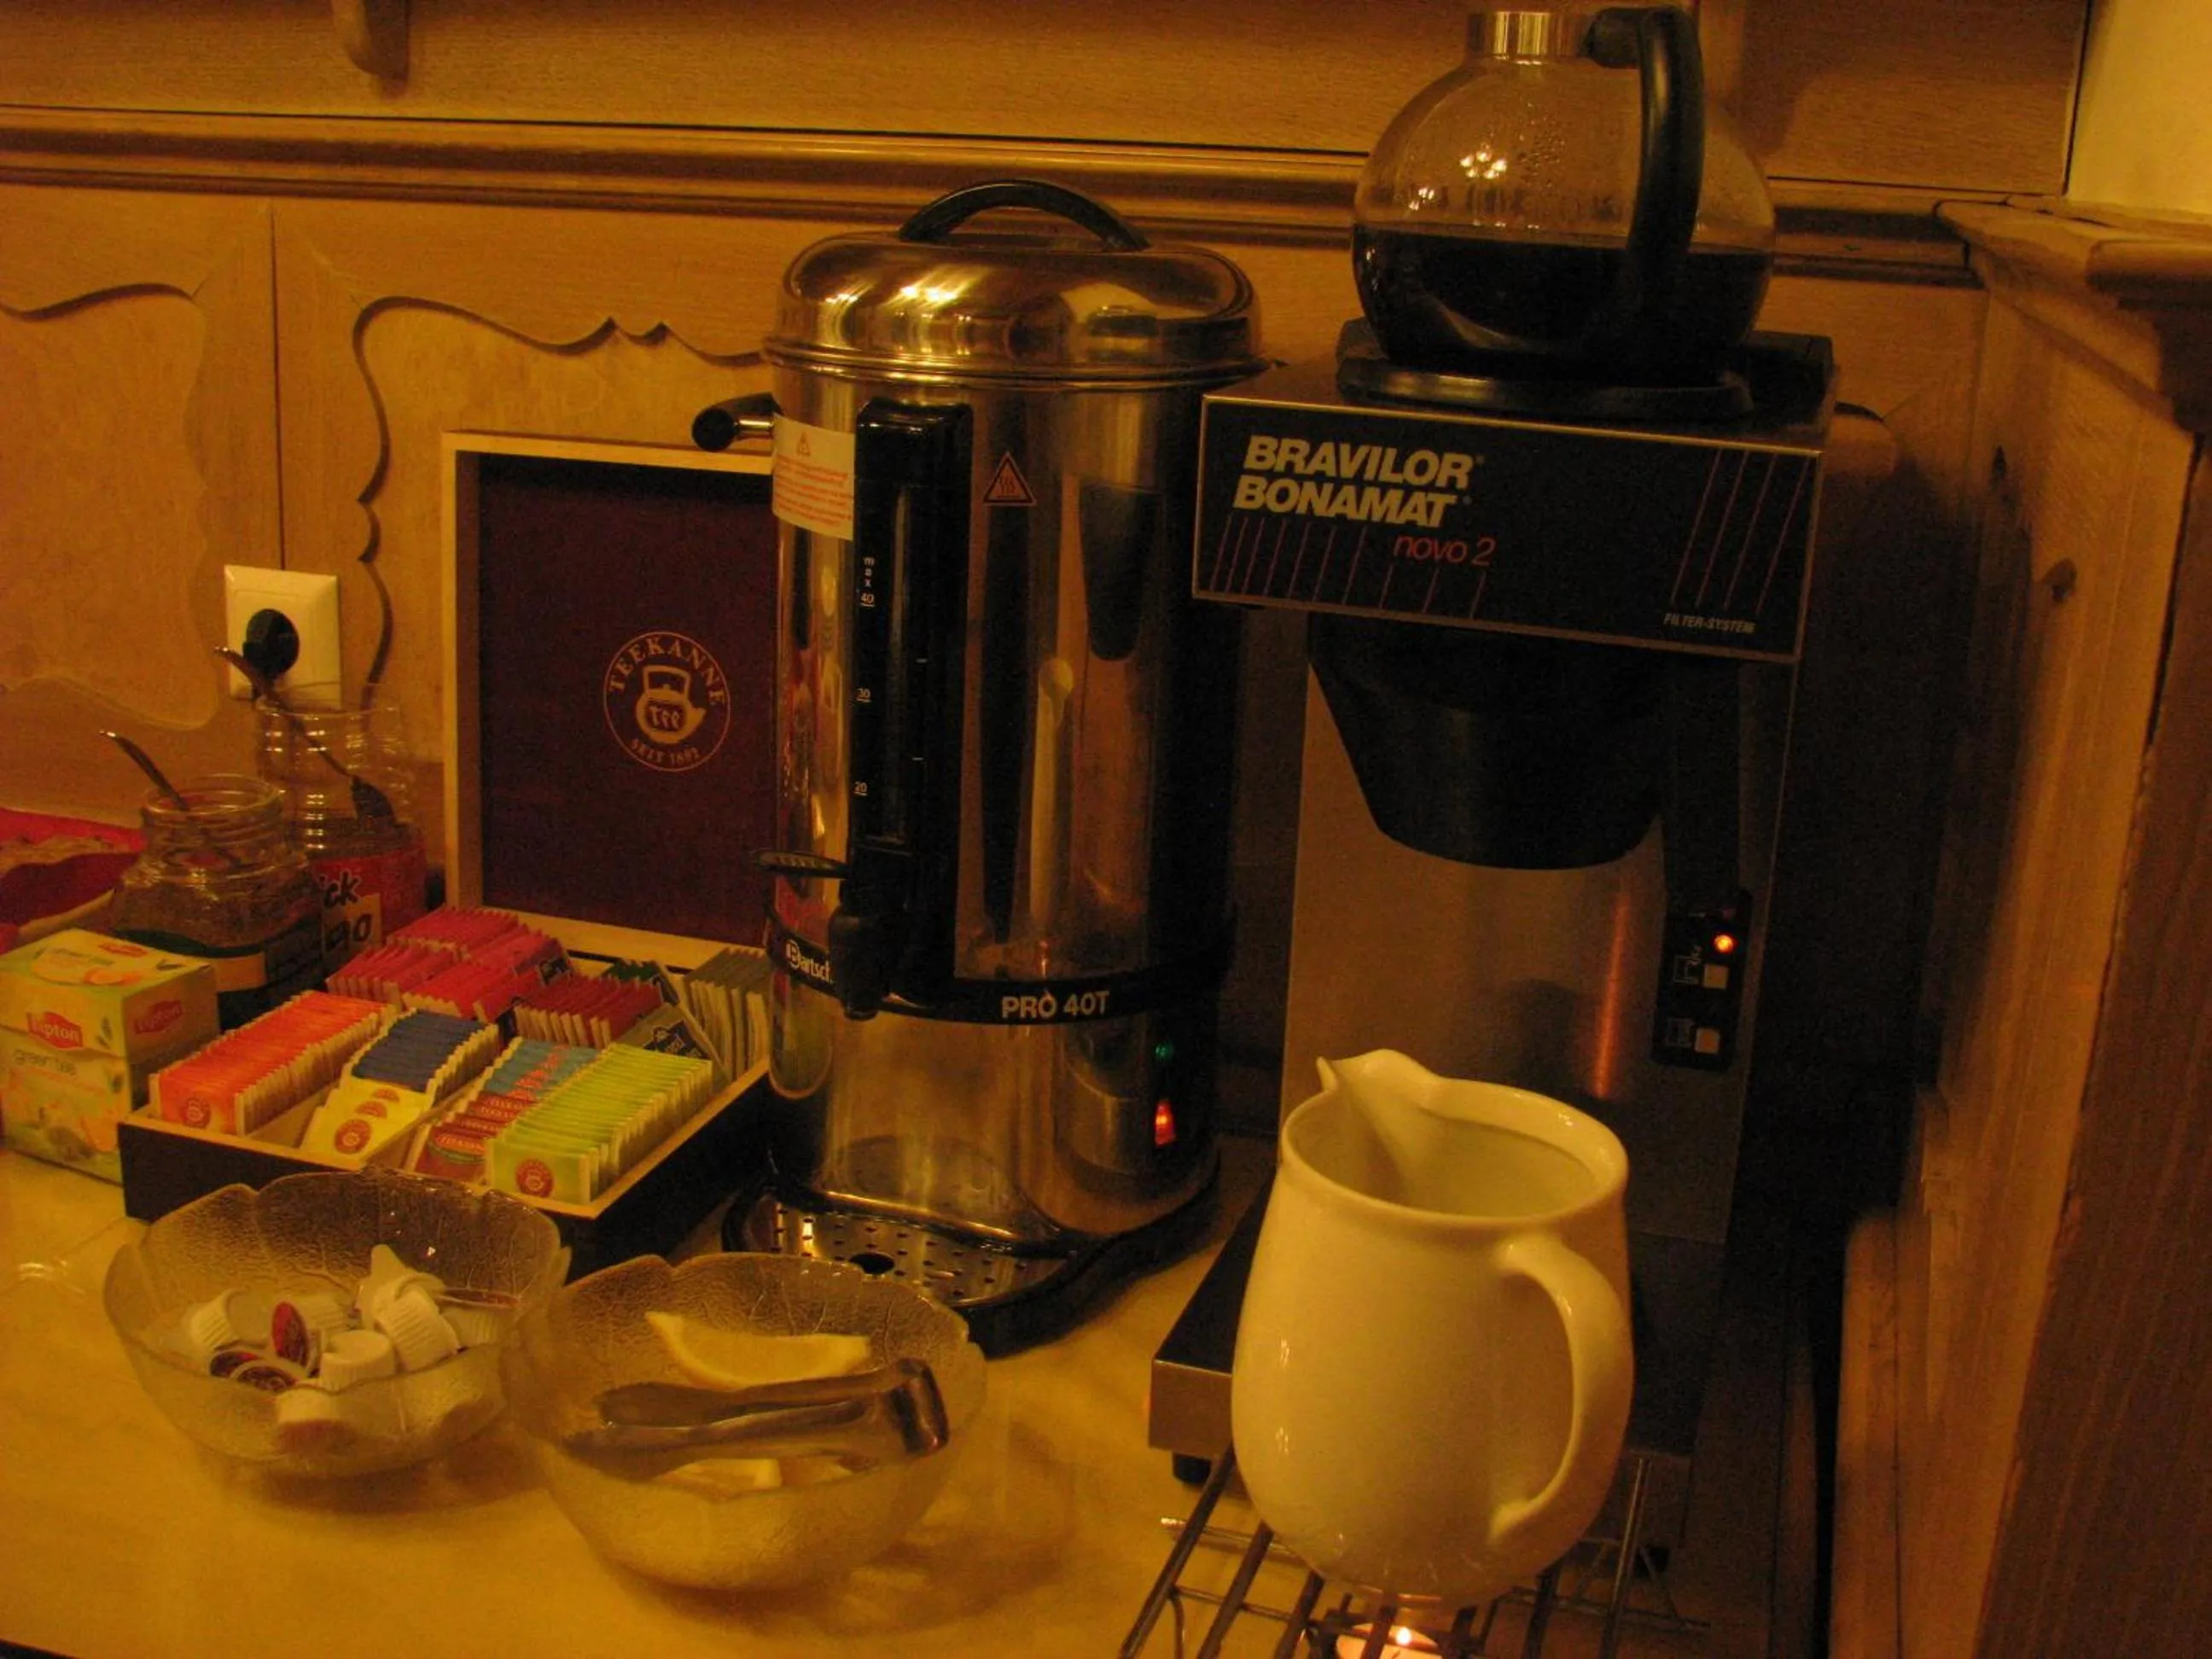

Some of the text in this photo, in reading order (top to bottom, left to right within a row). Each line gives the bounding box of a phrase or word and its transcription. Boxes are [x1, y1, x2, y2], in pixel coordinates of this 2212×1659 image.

[1243, 434, 1476, 491] BRAVILOR
[1232, 474, 1458, 528] BONAMAT
[1393, 533, 1498, 568] novo 2
[608, 637, 725, 707] TEEKANNE
[1000, 990, 1109, 1020] PRO 40T
